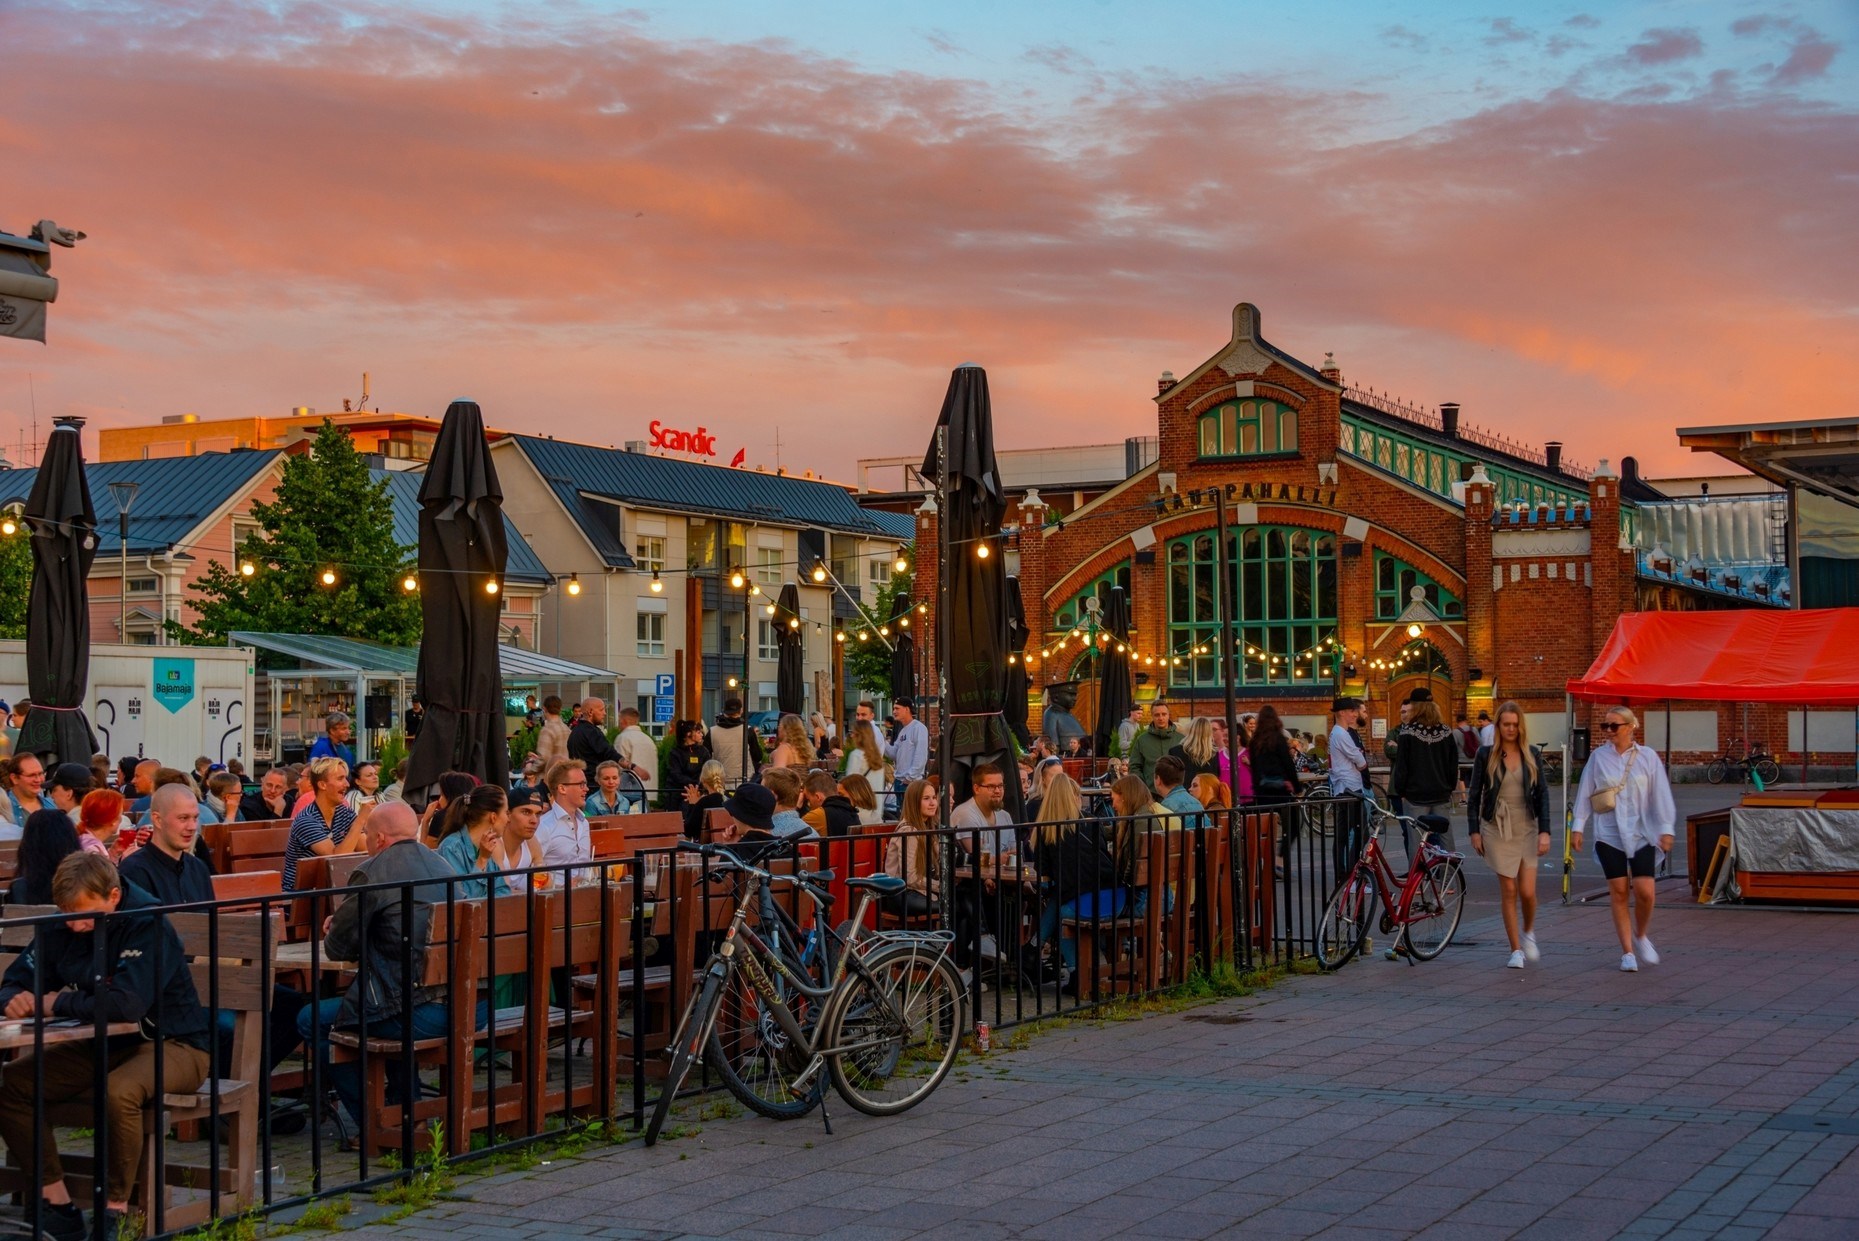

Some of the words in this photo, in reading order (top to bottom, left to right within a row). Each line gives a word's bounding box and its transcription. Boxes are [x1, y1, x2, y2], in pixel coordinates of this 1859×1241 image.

[649, 420, 716, 456] Scandic
[1154, 482, 1336, 515] KAUPPAHALLI
[156, 683, 192, 695] Bajamaja
[659, 675, 673, 695] P
